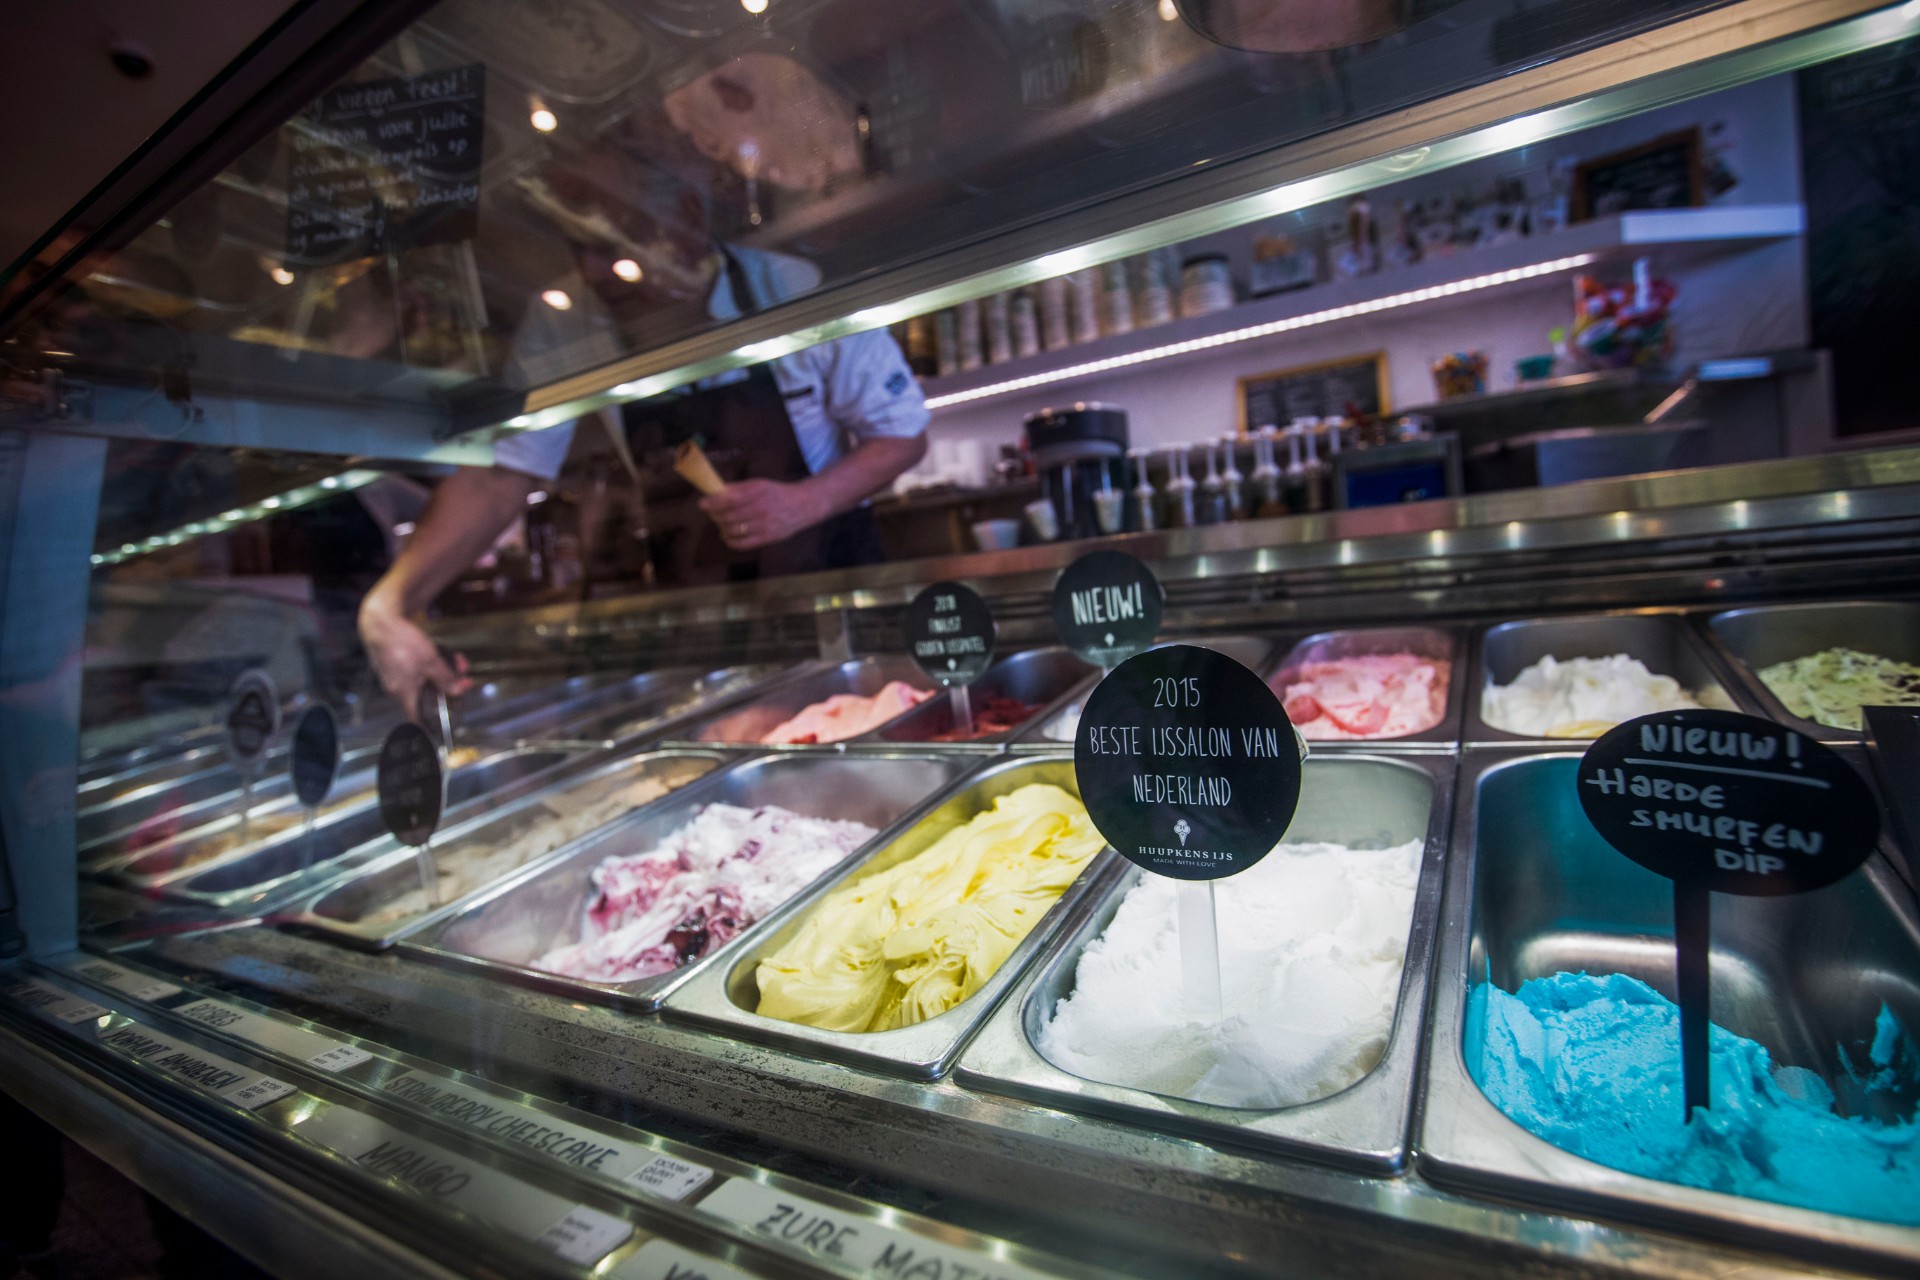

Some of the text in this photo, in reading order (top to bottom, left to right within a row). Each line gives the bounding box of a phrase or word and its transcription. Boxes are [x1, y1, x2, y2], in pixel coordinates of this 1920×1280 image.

[1071, 582, 1144, 625] NIEUW!
[1153, 677, 1201, 708] 2015
[1089, 726, 1279, 758] BESTE IJSSALON VAN
[1133, 774, 1232, 806] NEDERLAND
[1138, 847, 1234, 861] HUUPKENS IJS
[1152, 857, 1175, 865] MADE
[1196, 860, 1217, 868] LOVE
[385, 1076, 620, 1171] STRAWBERRY CHEESCAKE
[357, 1140, 471, 1197] MANGO
[756, 1203, 859, 1256] ZURE
